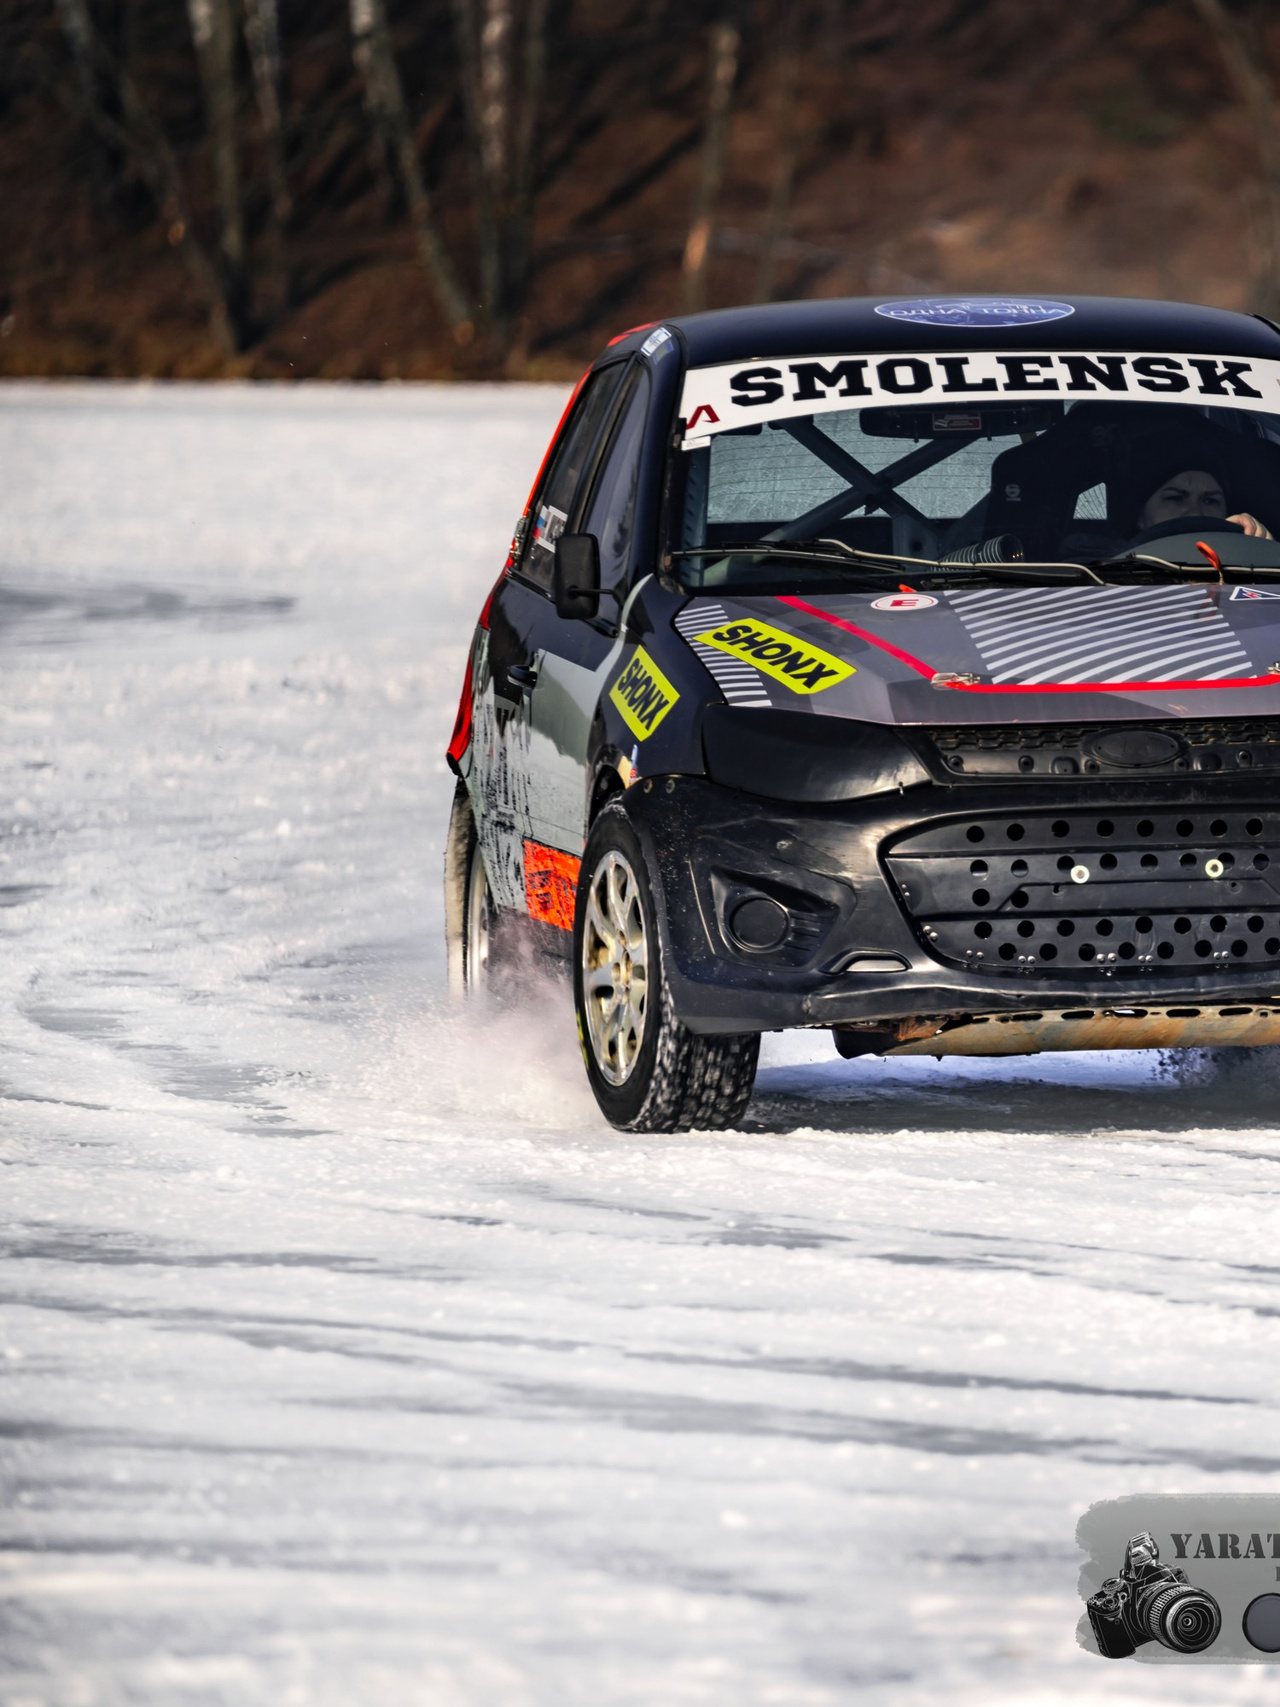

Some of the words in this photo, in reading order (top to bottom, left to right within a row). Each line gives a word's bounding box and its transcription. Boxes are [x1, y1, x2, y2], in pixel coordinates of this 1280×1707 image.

[729, 355, 1263, 407] SMOLENSK
[712, 625, 839, 688] SHONX
[617, 657, 670, 731] SHONX
